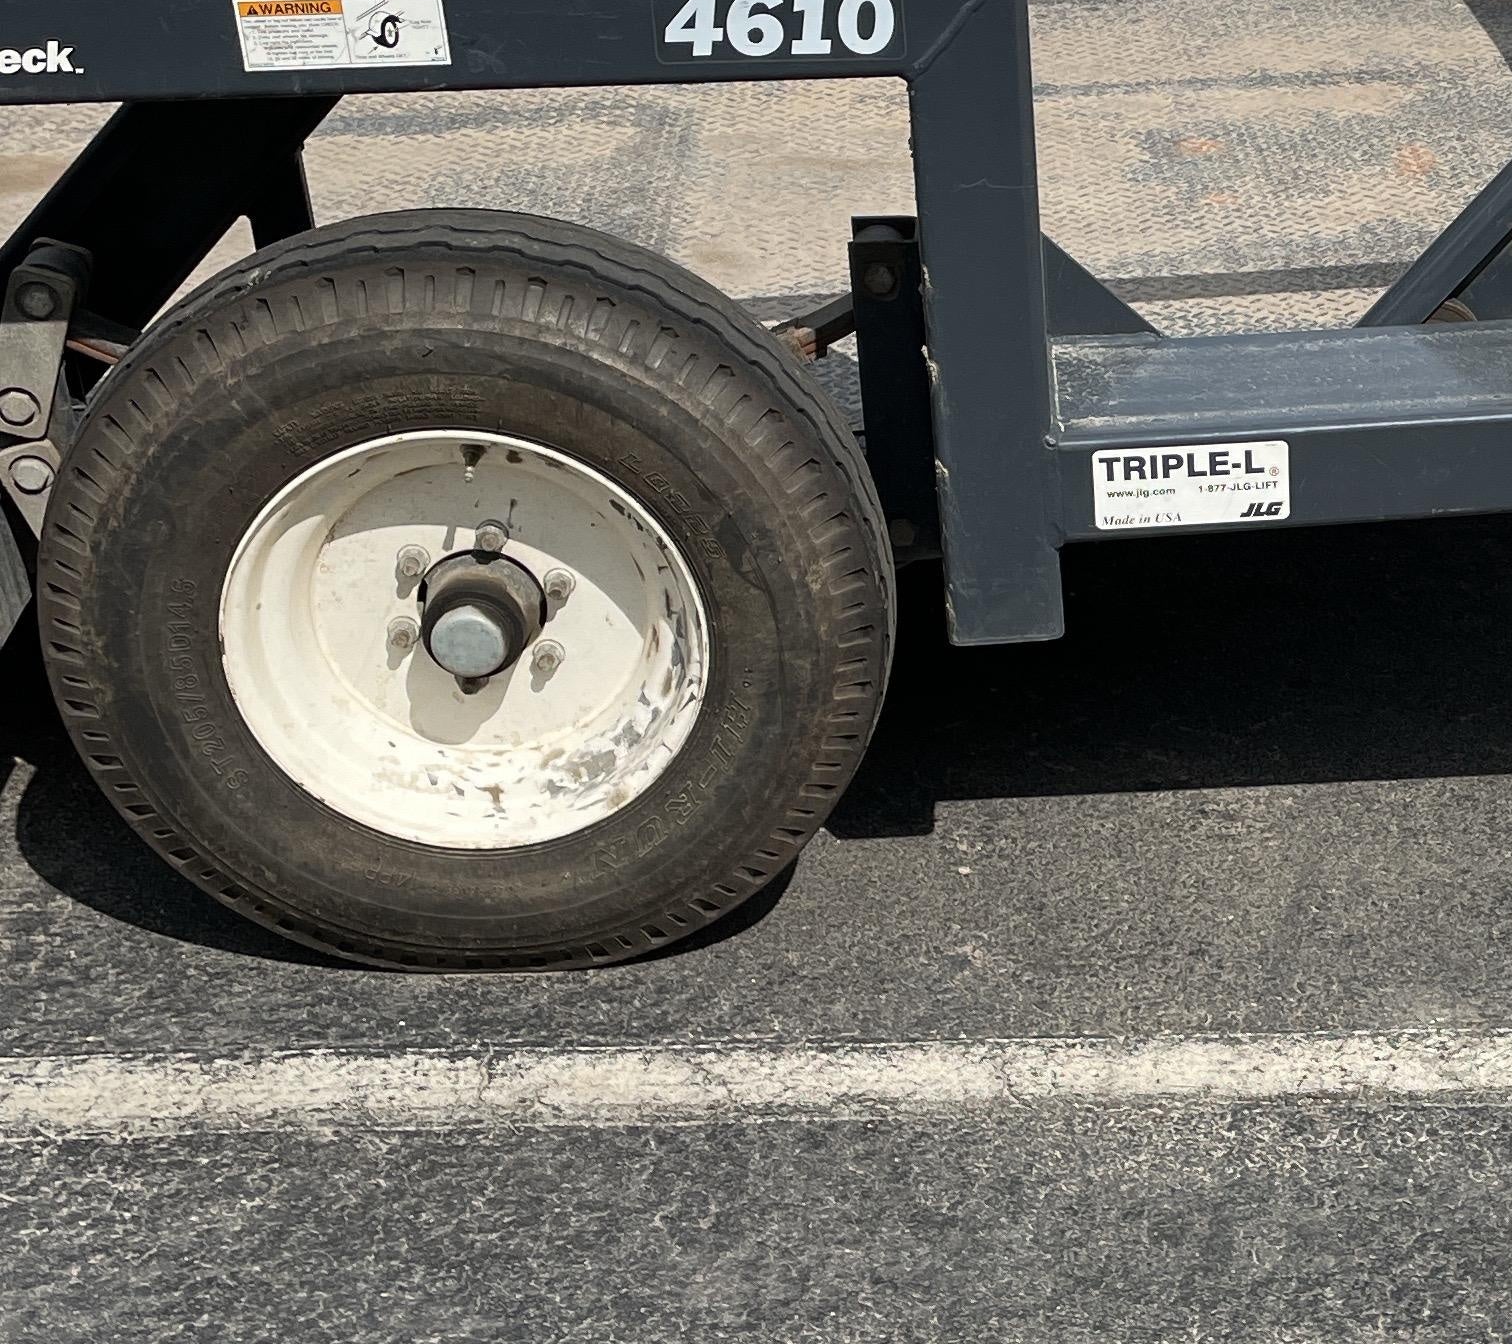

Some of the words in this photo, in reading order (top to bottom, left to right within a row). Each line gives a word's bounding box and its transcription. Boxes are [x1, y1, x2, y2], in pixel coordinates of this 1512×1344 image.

[259, 1, 332, 15] WARNING
[1098, 449, 1265, 482] TRIPLE-L
[1107, 486, 1176, 498] www.jlg.com
[1199, 481, 1278, 493] 1-877-JLG-LIFT
[1240, 501, 1283, 518] JLG
[1102, 515, 1136, 526] Made
[1138, 516, 1151, 524] in
[1155, 512, 1182, 523] USA
